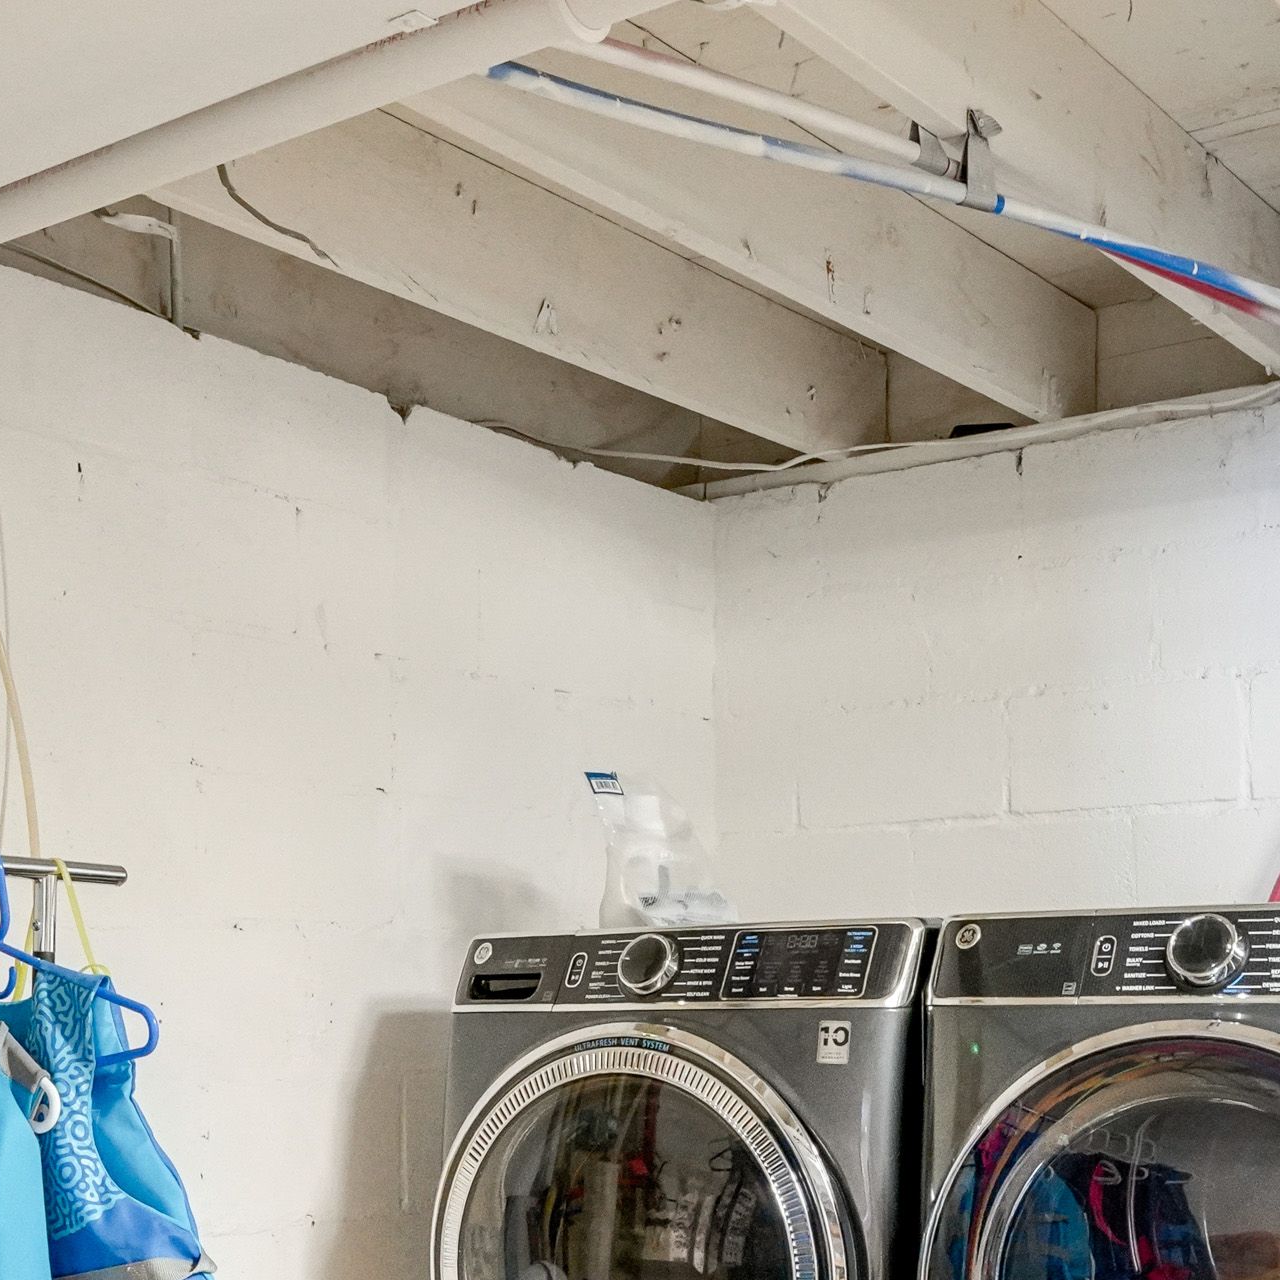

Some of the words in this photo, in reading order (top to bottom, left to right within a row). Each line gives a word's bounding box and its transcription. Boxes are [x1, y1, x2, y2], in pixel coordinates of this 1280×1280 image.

[574, 1038, 617, 1052] ULTRAFRESH
[620, 1037, 639, 1046] VENT
[642, 1039, 670, 1052] SYSTEM
